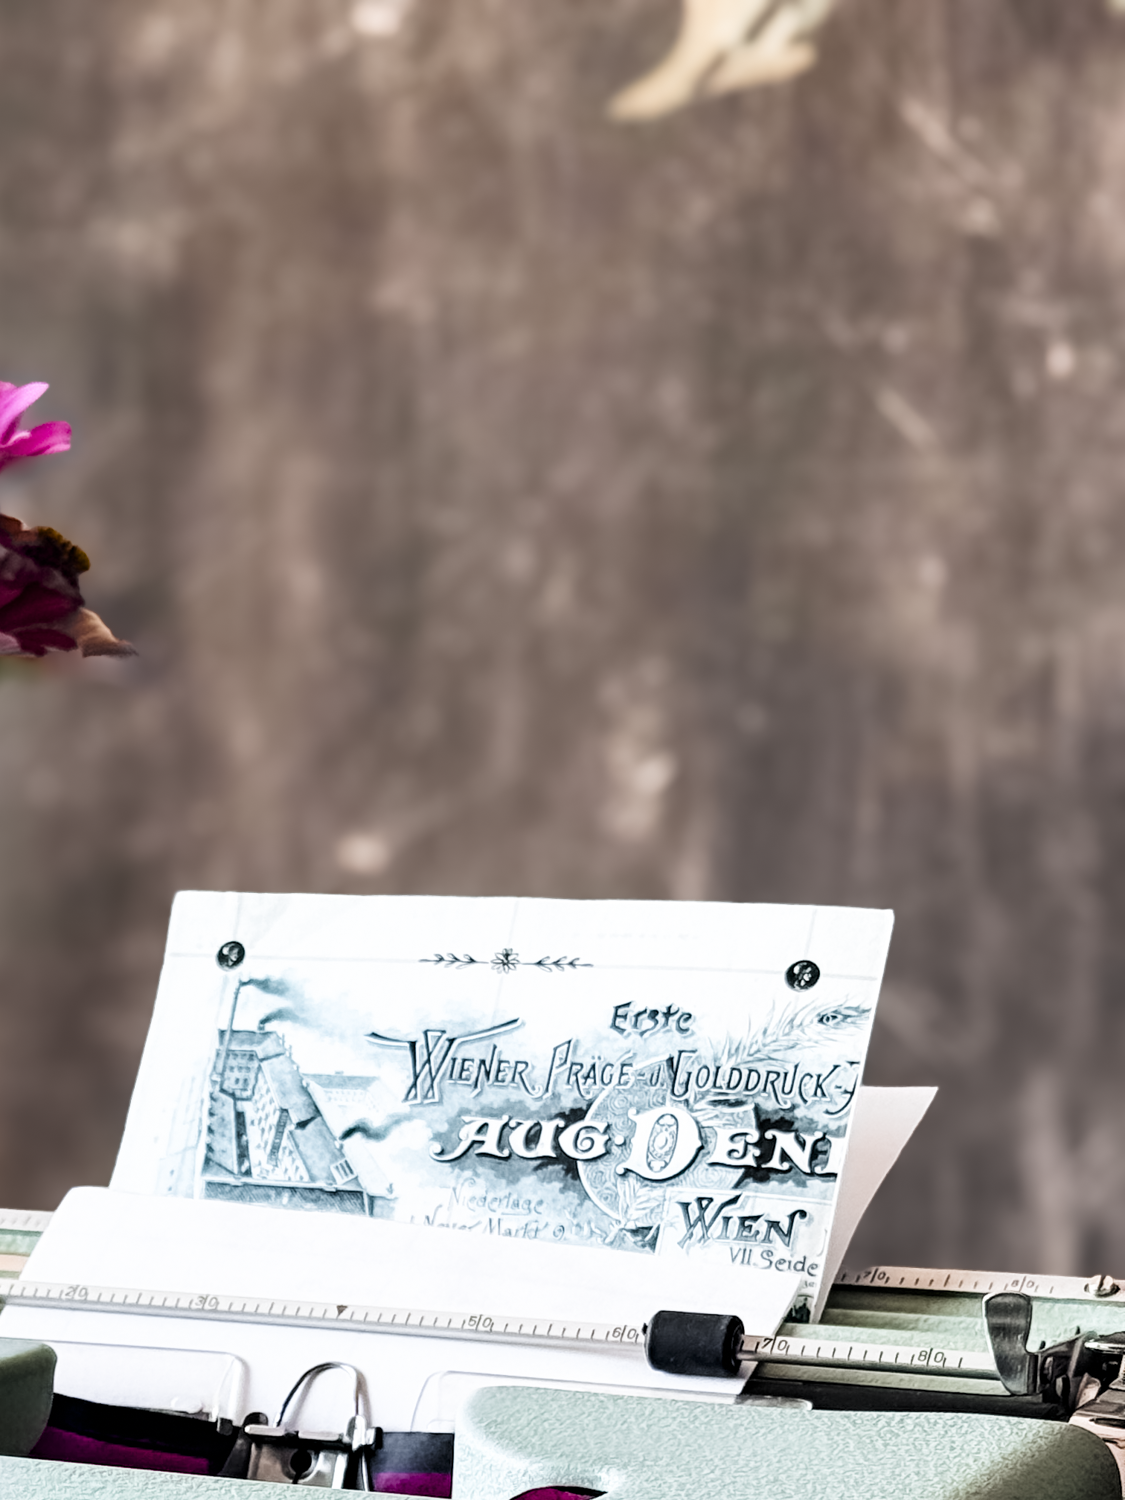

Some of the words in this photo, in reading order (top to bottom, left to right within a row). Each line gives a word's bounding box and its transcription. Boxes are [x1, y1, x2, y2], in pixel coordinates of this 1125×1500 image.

[610, 1001, 693, 1037] Erste
[677, 1194, 808, 1248] WIEN
[467, 1314, 493, 1331] 50
[611, 1325, 638, 1343] 60
[761, 1337, 788, 1354] 70
[916, 1348, 945, 1366] 80
